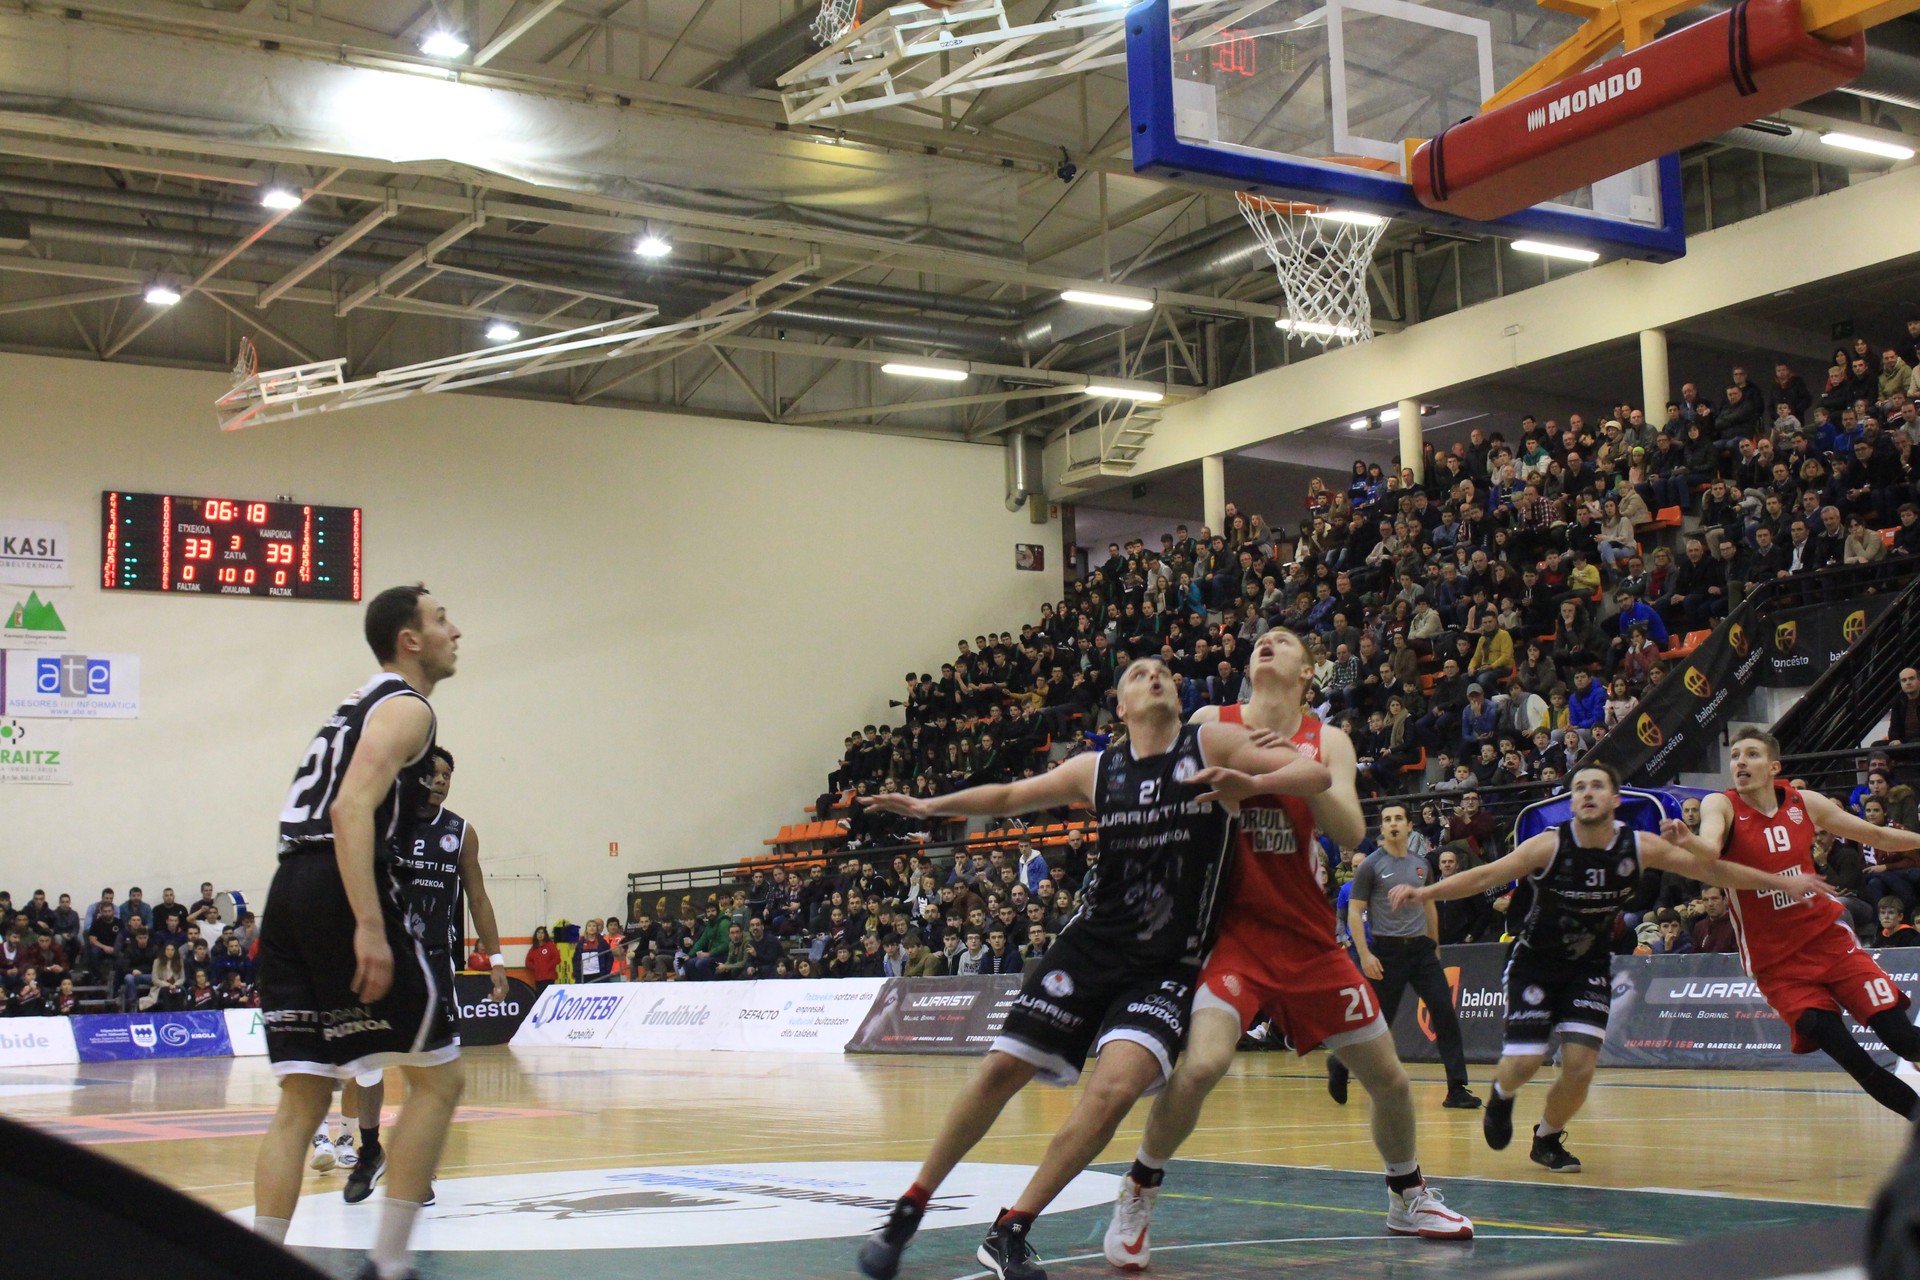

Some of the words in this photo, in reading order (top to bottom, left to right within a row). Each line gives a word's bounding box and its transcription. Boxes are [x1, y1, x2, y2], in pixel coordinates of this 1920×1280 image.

[1548, 66, 1642, 125] MONDO
[205, 500, 266, 523] 06:18
[178, 523, 211, 535] ETXEKOA
[260, 529, 292, 539] KANPOKOA
[185, 538, 212, 559] 33
[230, 535, 241, 550] 3
[223, 551, 247, 560] ZATIA
[266, 543, 293, 563] 39
[183, 565, 194, 580] 0
[244, 568, 255, 583] 0
[275, 570, 285, 585] 0
[176, 582, 201, 592] FALTAK
[220, 585, 251, 595] JOKALARIA
[269, 587, 293, 597] FALTAK
[38, 658, 109, 695] ate
[9, 700, 58, 708] ASESORES
[1694, 687, 1729, 723] baloncesto
[0, 749, 61, 765] RAITZ
[1645, 732, 1685, 772] baloncesto
[279, 725, 352, 823] 21
[1763, 825, 1792, 853] 19
[413, 839, 425, 856] 2
[1585, 867, 1606, 887] 31
[1863, 977, 1896, 1007] 19
[556, 995, 624, 1021] CORTEBI
[912, 995, 975, 1007] JUARISTI
[1339, 983, 1375, 1022] 21
[641, 998, 712, 1027] fundibide
[738, 1008, 780, 1021] DEFACTO
[1459, 1008, 1495, 1019] ESPAÑA
[0, 1031, 49, 1049] bide
[566, 1028, 596, 1042] Azpeitia
[1624, 1040, 1672, 1048] JUARISTI
[1706, 1042, 1743, 1050] BABESLE
